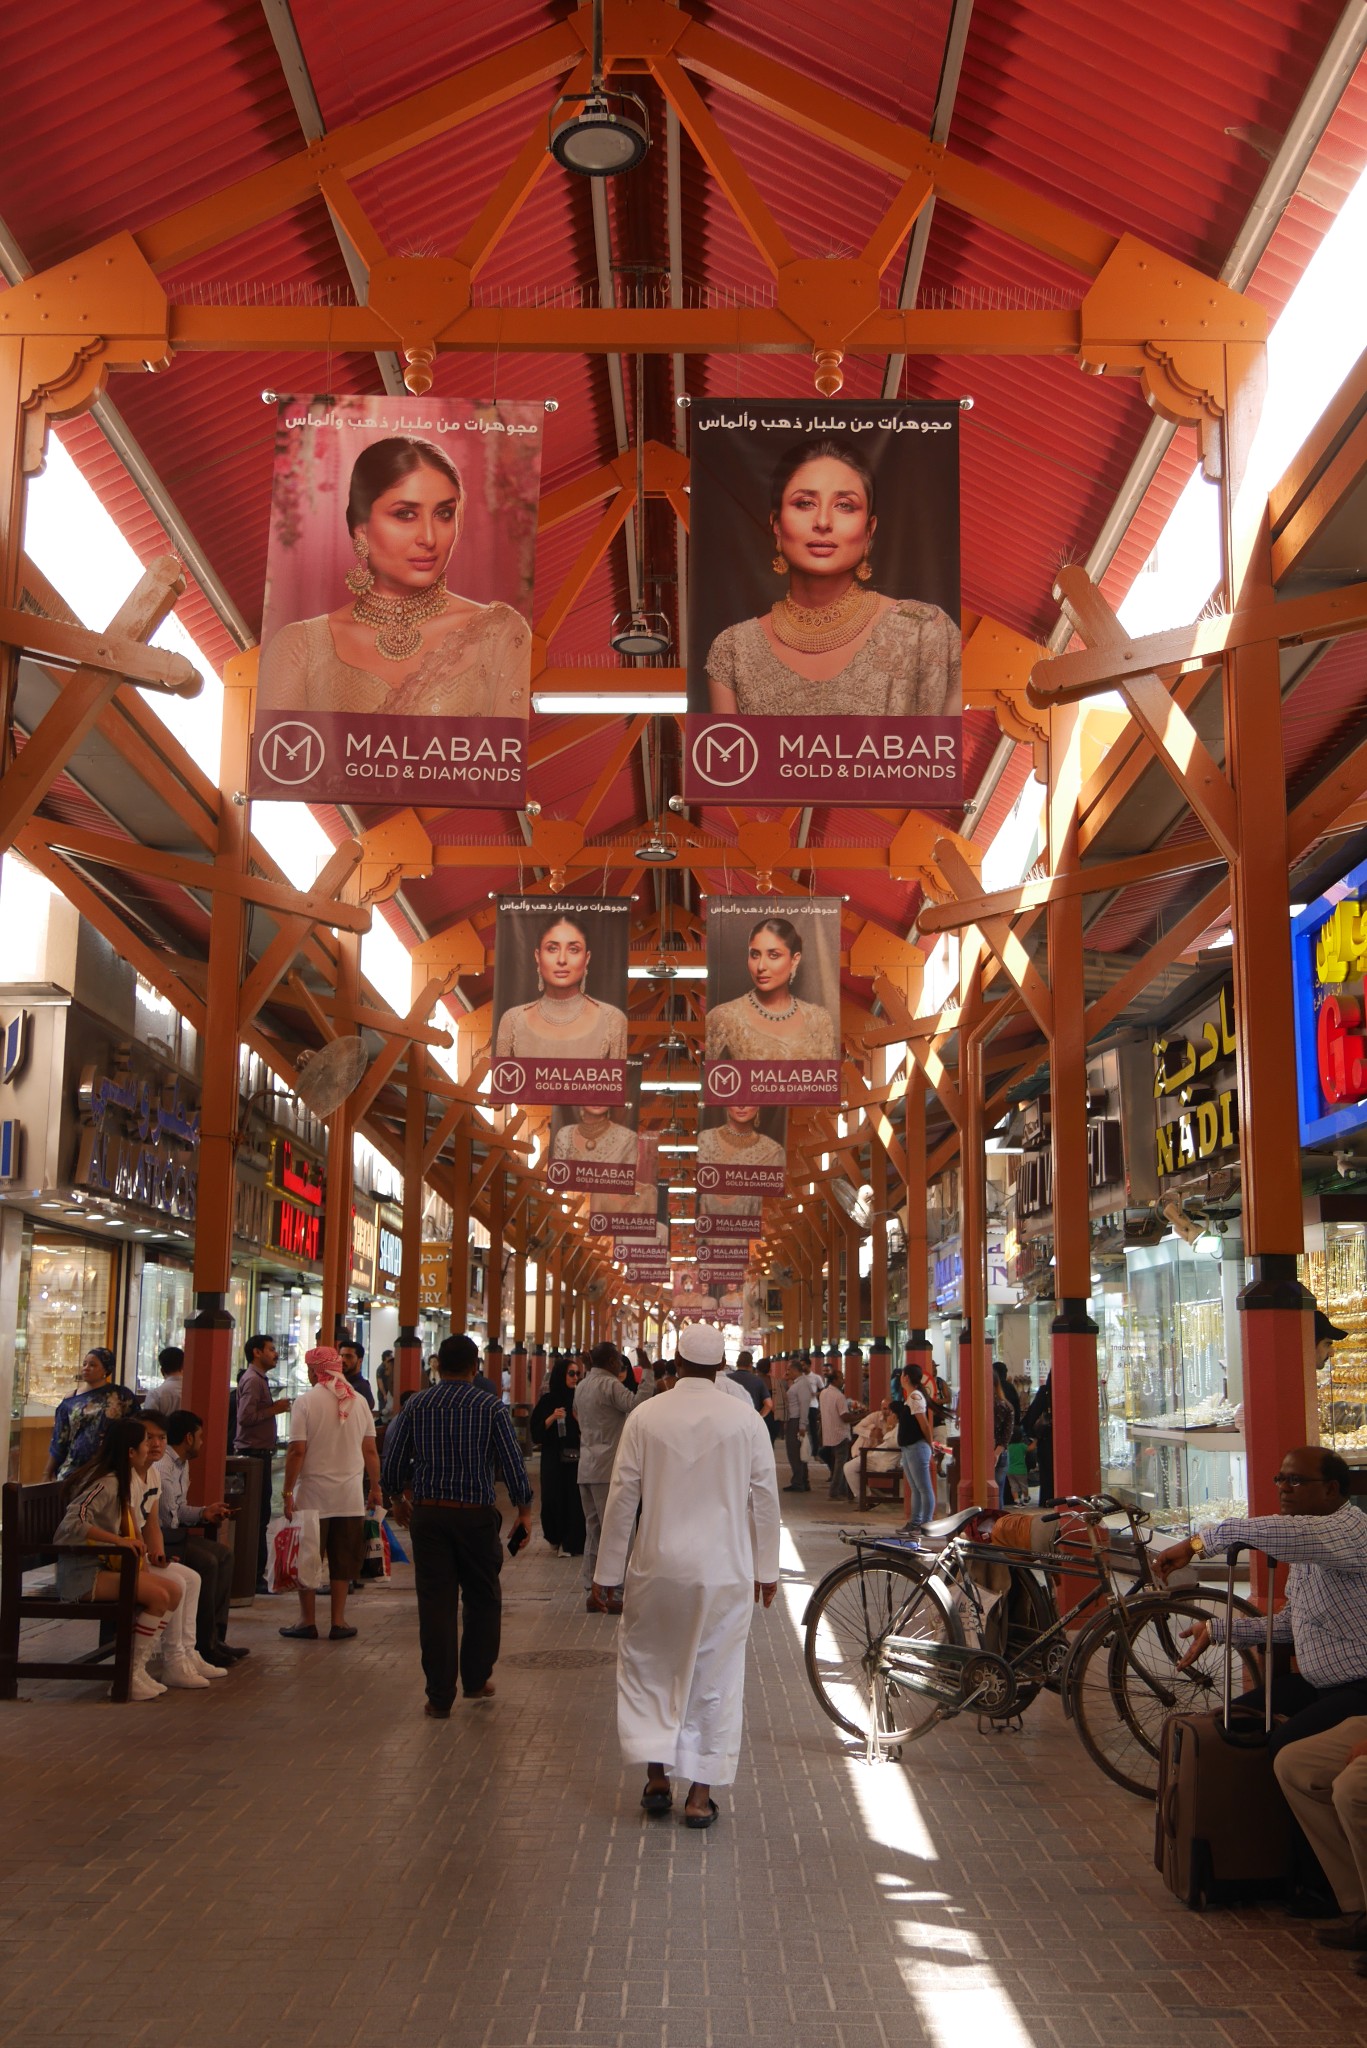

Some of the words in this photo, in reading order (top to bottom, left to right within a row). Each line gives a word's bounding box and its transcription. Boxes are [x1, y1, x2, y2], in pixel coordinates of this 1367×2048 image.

[285, 411, 344, 430] وألماس
[347, 417, 389, 430] ذهب
[391, 416, 433, 432] ملبار
[436, 418, 460, 433] من
[464, 417, 538, 436] مجوهرات
[698, 412, 757, 431] وألماس
[761, 417, 803, 431] ذهب
[805, 416, 847, 433] ملبار
[850, 418, 874, 433] من
[878, 416, 952, 433] مجوهرات
[346, 733, 522, 763] MALABAR
[779, 734, 956, 760] MALABAR
[345, 763, 399, 778] GOLD
[402, 765, 414, 779] &
[419, 766, 521, 782] DIAMONDS
[779, 764, 833, 778] GOLD
[837, 764, 849, 778] &
[853, 765, 956, 779] DIAMONDS
[535, 1067, 623, 1082] MALABAR
[750, 1069, 838, 1083] MALABAR
[563, 1083, 570, 1091] &
[571, 1083, 623, 1092] DIAMONDS
[750, 1084, 777, 1093] GOLD
[779, 1085, 785, 1093] &
[787, 1084, 838, 1093] DIAMONDS
[576, 1167, 635, 1180] MALABAR
[725, 1171, 784, 1182] MALABAR
[611, 1217, 656, 1226] MALABAR
[716, 1219, 760, 1228] MALABAR
[279, 1199, 319, 1261] HIMAT
